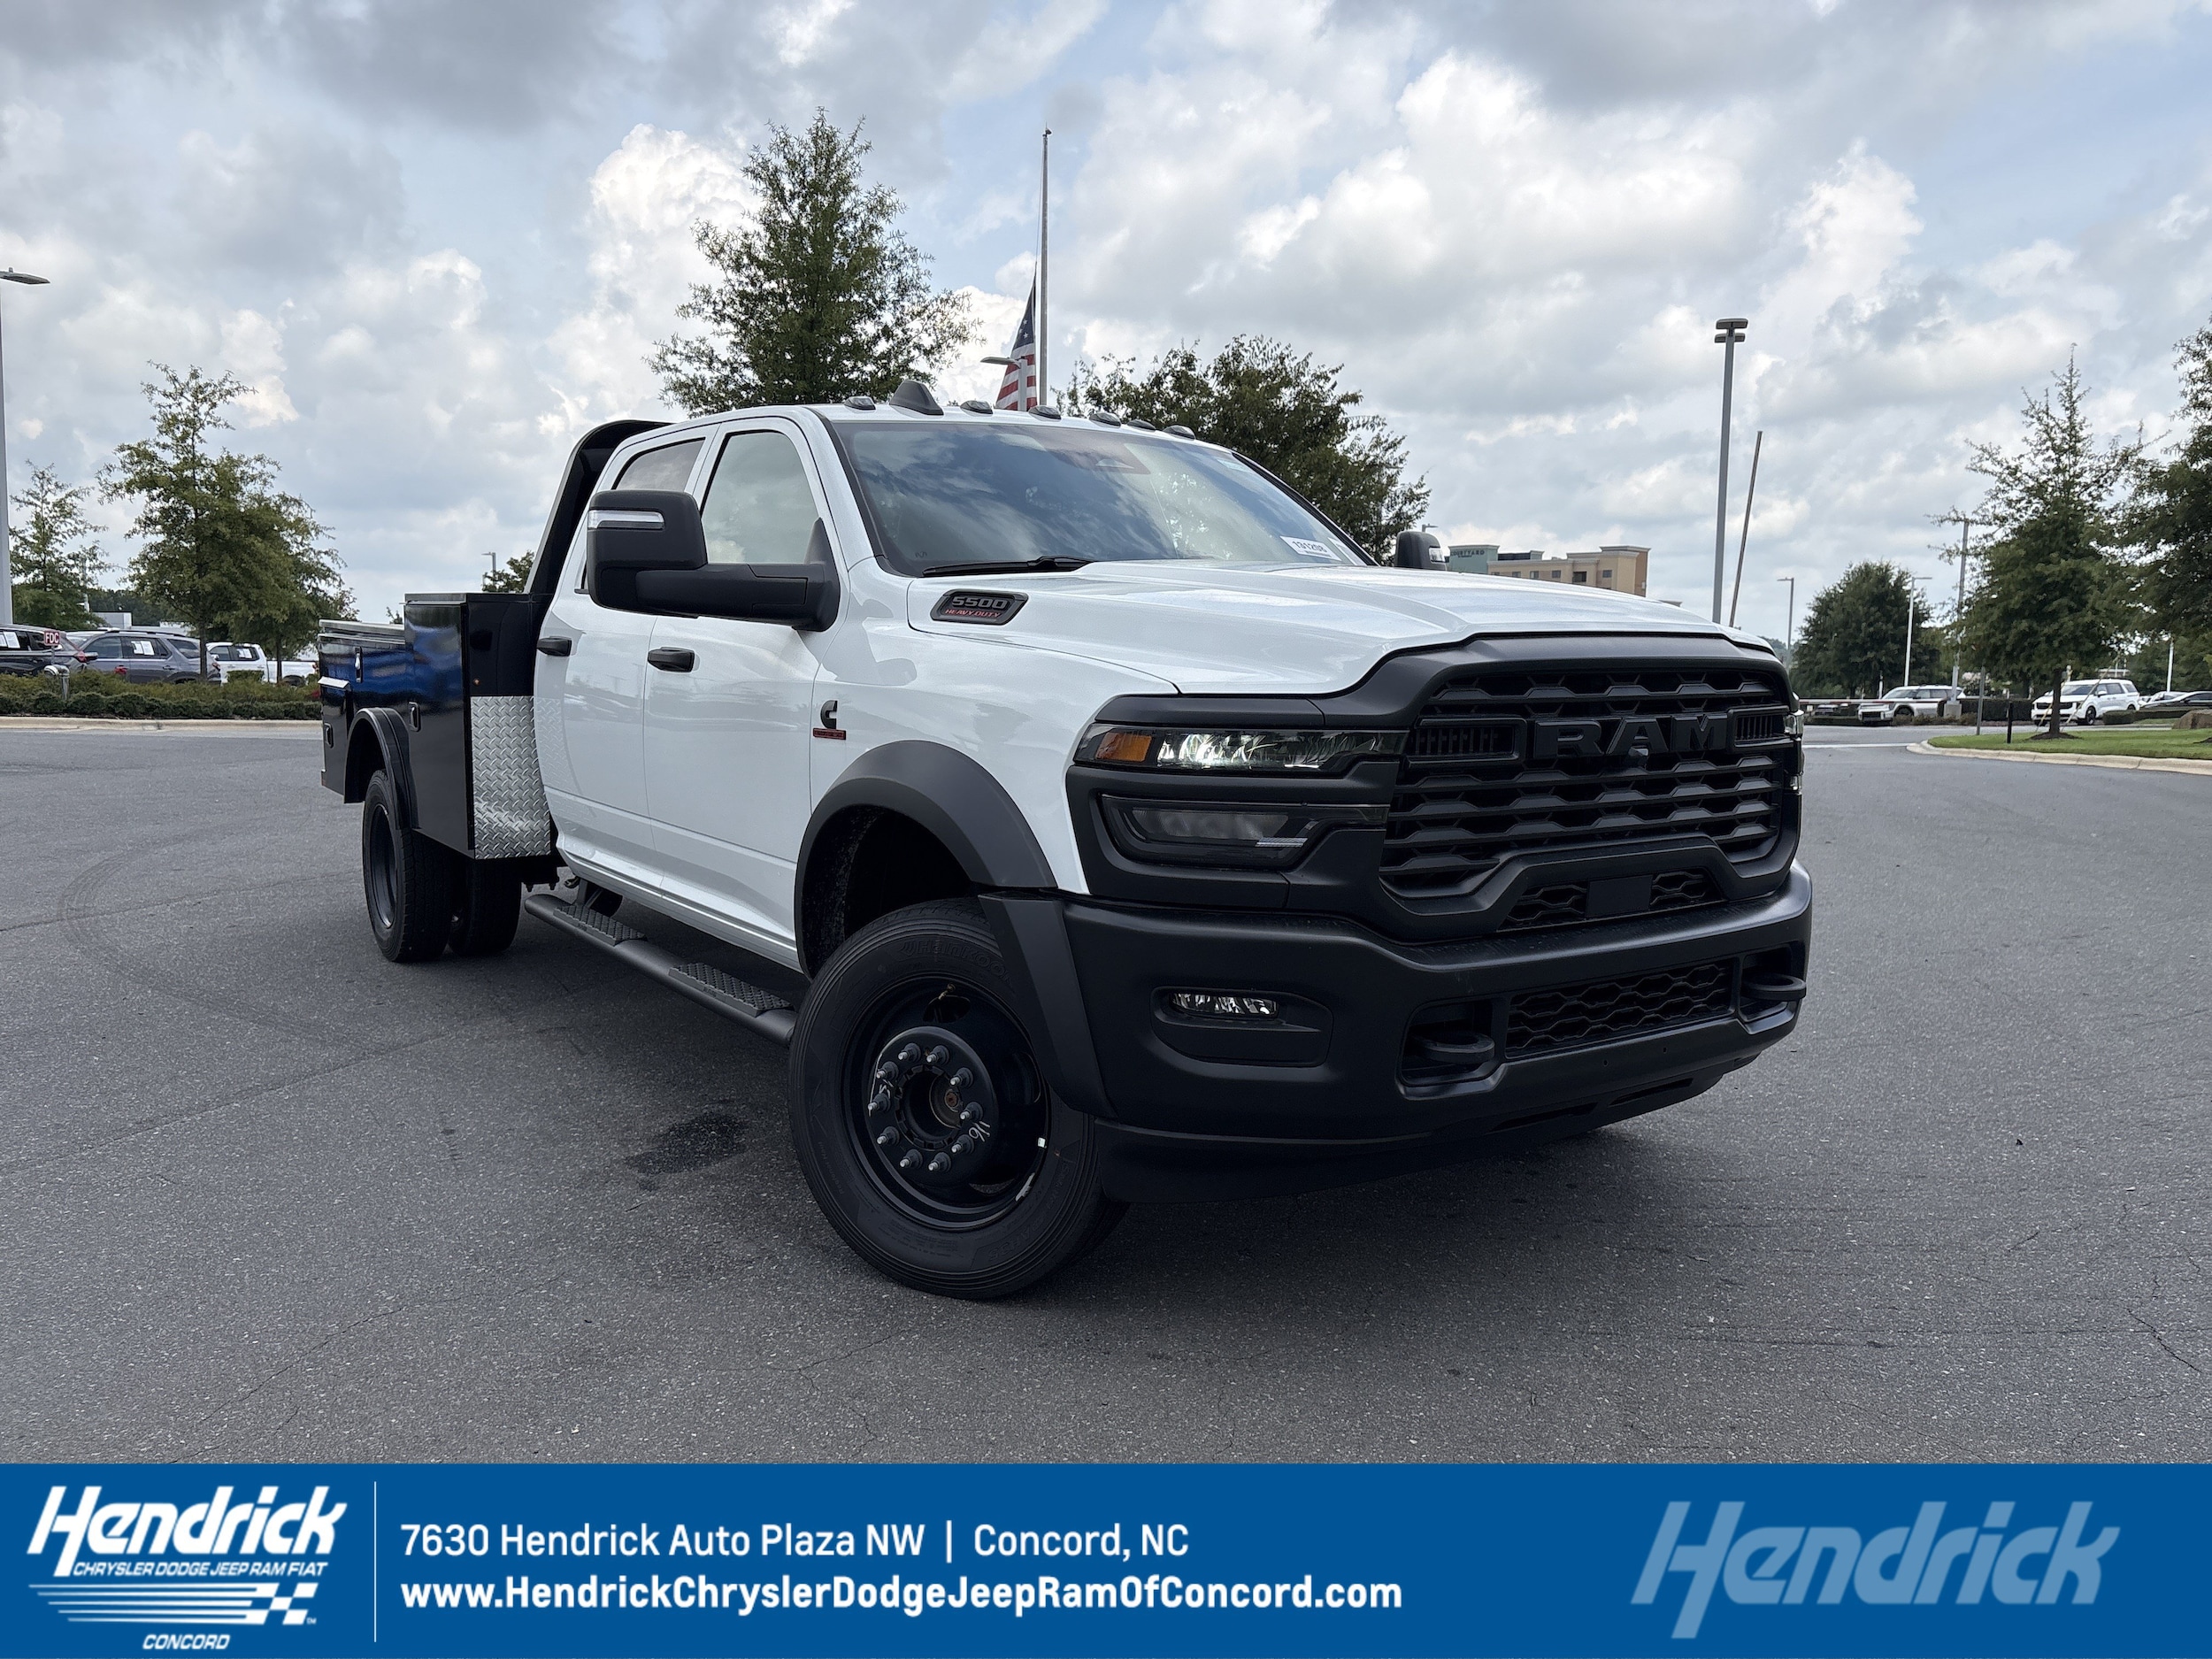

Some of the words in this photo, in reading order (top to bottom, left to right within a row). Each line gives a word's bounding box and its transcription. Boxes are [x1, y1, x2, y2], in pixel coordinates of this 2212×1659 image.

[951, 595, 1008, 610] 5500
[944, 608, 974, 617] HEAVY
[45, 632, 59, 644] FDC
[1532, 713, 1728, 760] RAM
